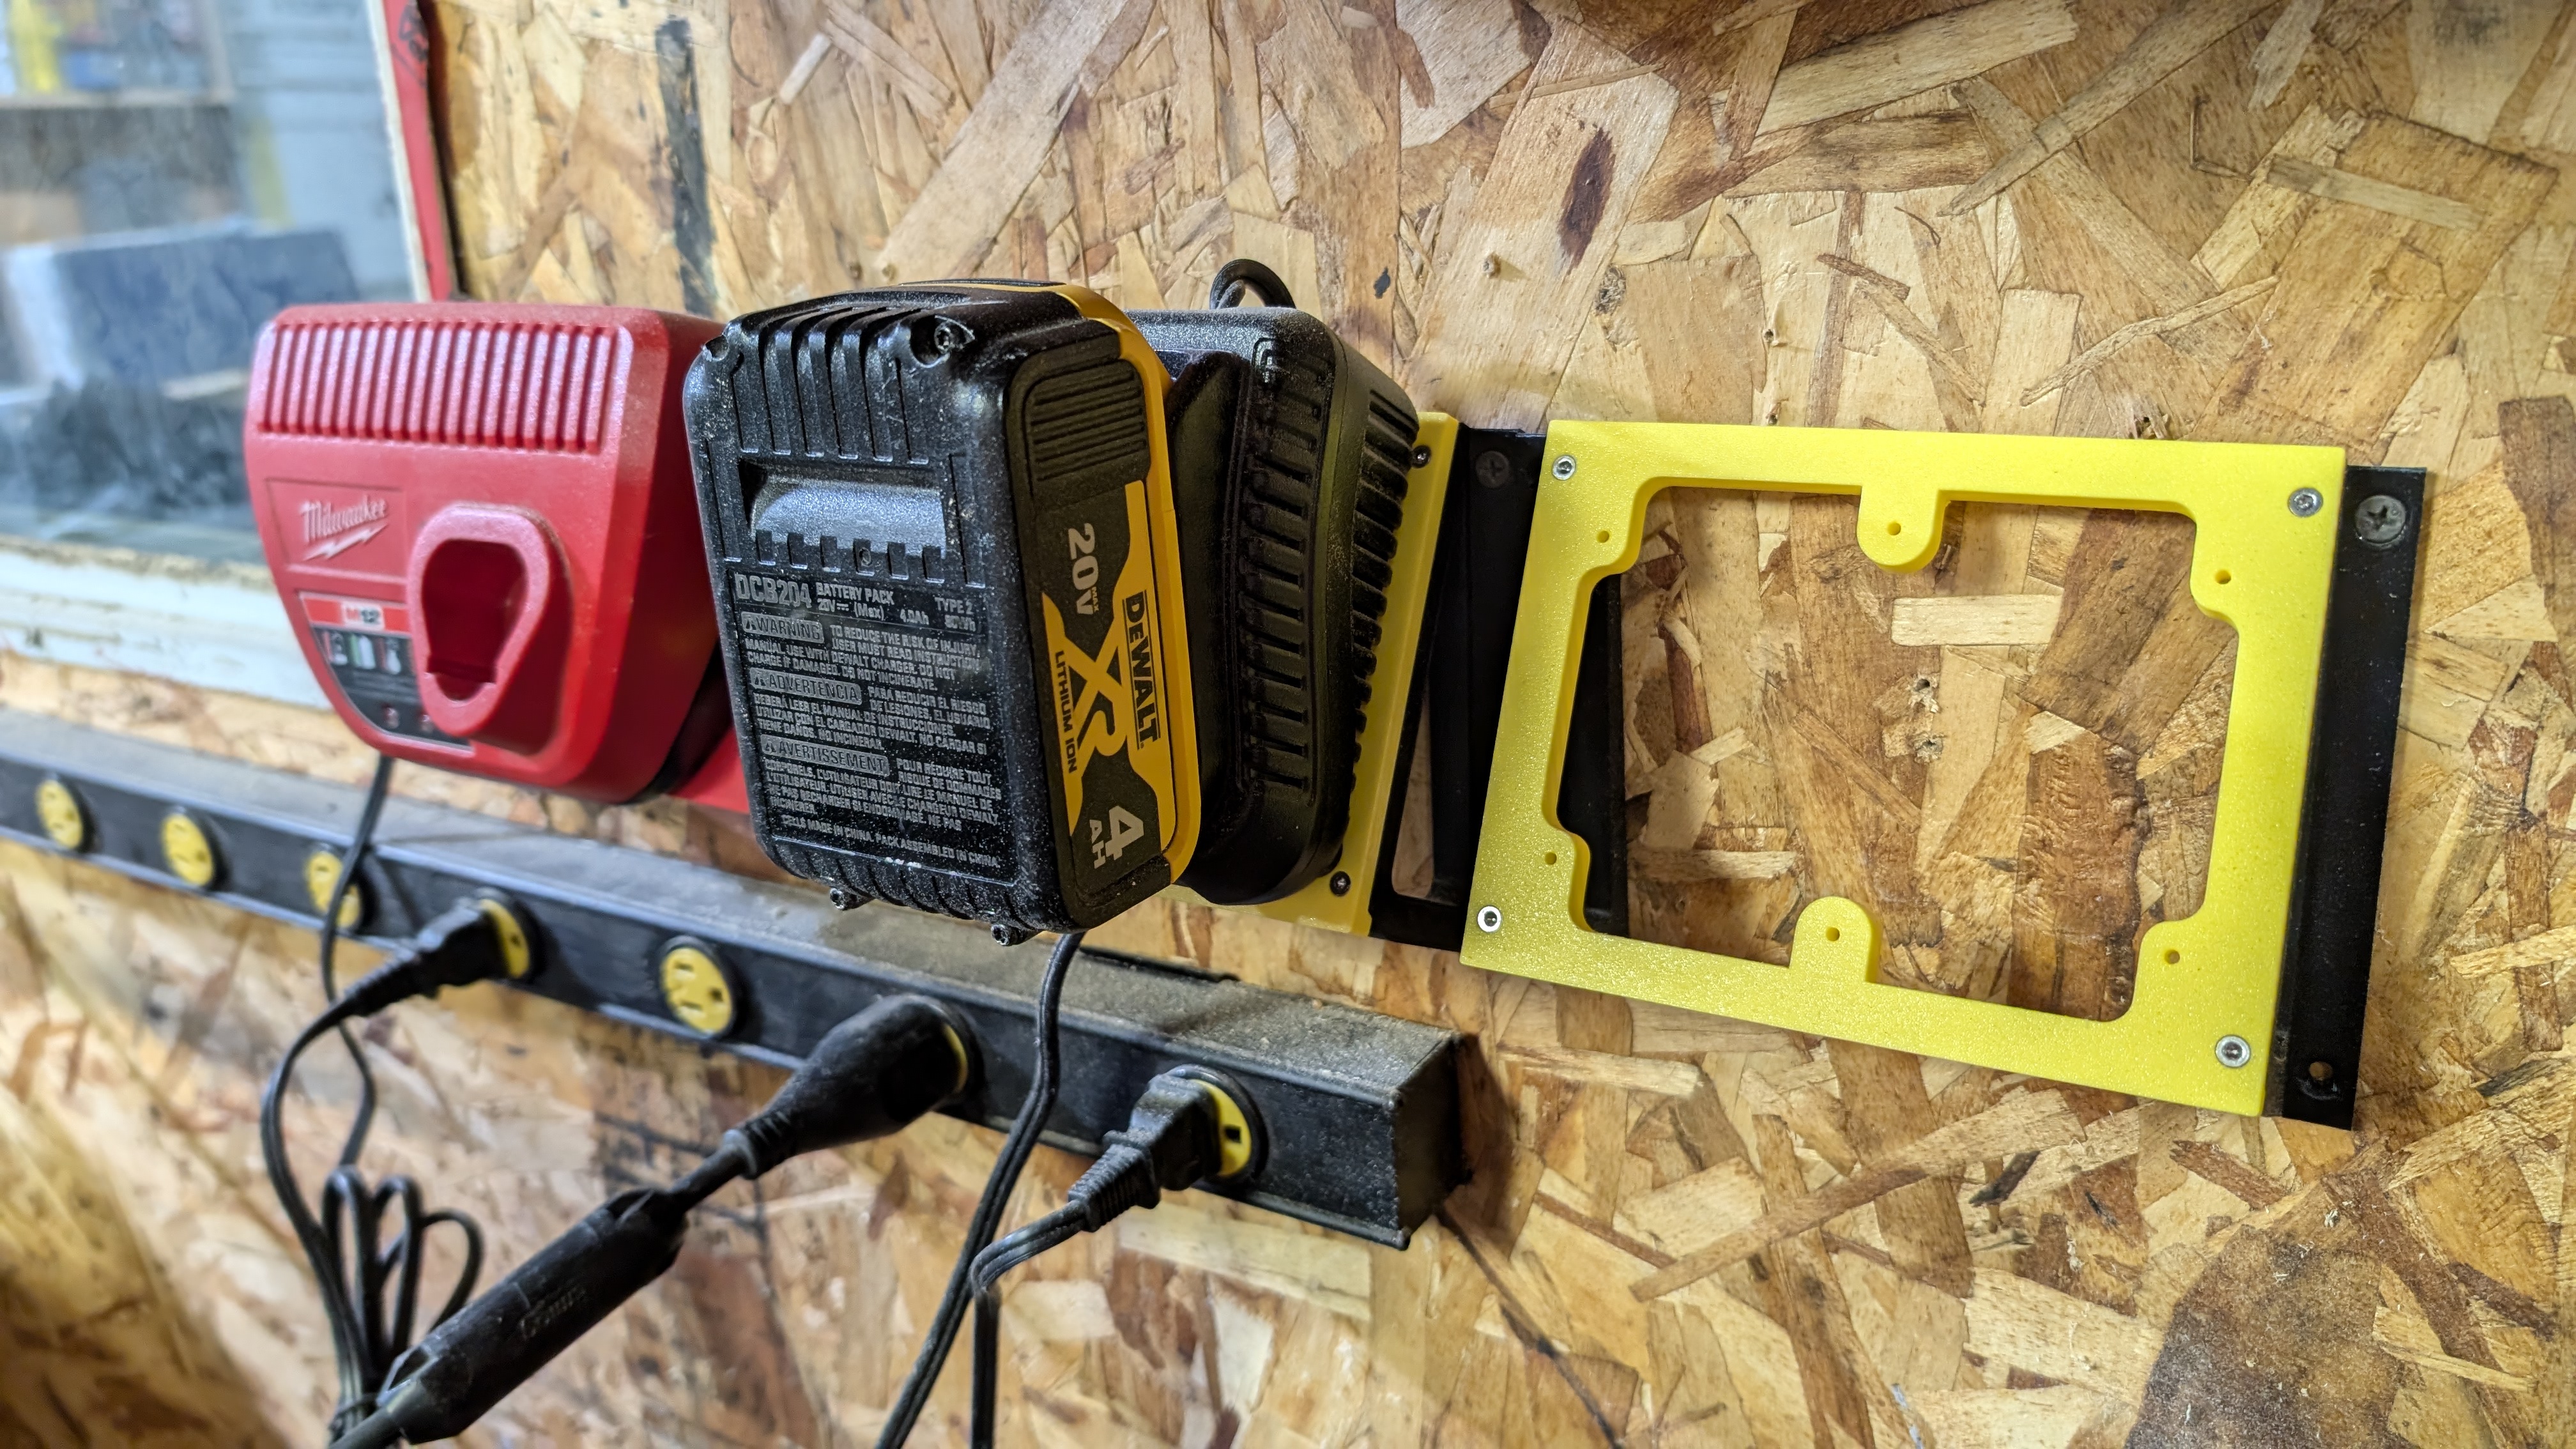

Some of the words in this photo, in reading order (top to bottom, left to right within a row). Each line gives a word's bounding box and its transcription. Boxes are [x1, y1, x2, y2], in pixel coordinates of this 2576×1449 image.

[300, 494, 388, 544] Milwaukee
[1068, 523, 1099, 615] 20V
[1091, 586, 1100, 613] MAX
[734, 573, 812, 608] DCB204
[815, 582, 862, 601] BATTERY
[864, 588, 894, 604] PACK
[935, 596, 964, 614] TYPE
[965, 600, 974, 615] 2
[346, 608, 381, 625] M12
[853, 601, 884, 621] (Max)
[755, 617, 820, 640] WARNING
[829, 624, 843, 637] TO
[844, 626, 880, 642] REDUCE
[882, 631, 900, 645] THE
[901, 634, 925, 648] RISK
[925, 638, 939, 650] OF
[785, 644, 805, 657] USE
[805, 647, 829, 661] WITH
[831, 650, 870, 667] DEWALT
[919, 664, 933, 677] DO
[934, 666, 955, 680] NOT
[831, 638, 856, 652] USER
[857, 641, 885, 656] MUST
[886, 646, 912, 660] READ
[746, 651, 782, 666] CHARGE
[783, 657, 791, 668] IF
[841, 665, 855, 678] DO
[857, 668, 875, 681] NOT
[1125, 591, 1158, 742] DEWALT
[767, 673, 858, 702] ADVERTENCIA
[868, 686, 894, 700] PARA
[894, 690, 936, 707] REDUCIR
[937, 696, 949, 709] EL
[950, 698, 986, 715] RIESGO
[788, 698, 809, 712] LEER
[811, 702, 822, 714] EL
[822, 703, 863, 721] MANUAL
[863, 710, 876, 723] DE
[870, 699, 883, 712] DE
[933, 709, 946, 722] EL
[946, 711, 990, 729] USUARIO
[1055, 650, 1073, 733] LITHIUM
[1065, 738, 1077, 774] ION
[755, 706, 793, 722] UTILIZAR
[794, 712, 814, 726] CON
[815, 716, 825, 728] EL
[826, 717, 876, 736] CARGADOR
[919, 732, 933, 746] NO
[935, 735, 975, 752] CARGAR
[976, 742, 987, 754] SI
[757, 718, 783, 733] TIENE
[818, 728, 832, 741] NO
[778, 740, 884, 772] AVERTISSEMENT
[896, 758, 923, 772] POUR
[965, 769, 992, 785] TOUT
[898, 770, 931, 787] RISQUE
[932, 777, 944, 789] DE
[946, 779, 1001, 799] DOMMAGES
[816, 769, 878, 790] L'UTILISATEUR
[879, 779, 901, 793] DOIT
[903, 783, 922, 797] LIRE
[923, 787, 935, 799] LE
[936, 789, 978, 807] MANUEL
[979, 797, 992, 809] DE
[829, 783, 868, 800] UTILISER
[869, 790, 894, 804] AVEC
[907, 796, 957, 816] CHARGEUR
[799, 790, 851, 809] RECHARGER
[927, 813, 941, 826] NE
[942, 816, 962, 830] PAS
[781, 814, 807, 829] CELLS
[807, 818, 832, 834] MADE
[832, 824, 843, 836] IN
[875, 831, 899, 847] PACK
[900, 836, 954, 857] ASSEMBLED
[955, 847, 967, 859] IN
[1089, 819, 1107, 870] AH
[1105, 805, 1144, 861] 4
